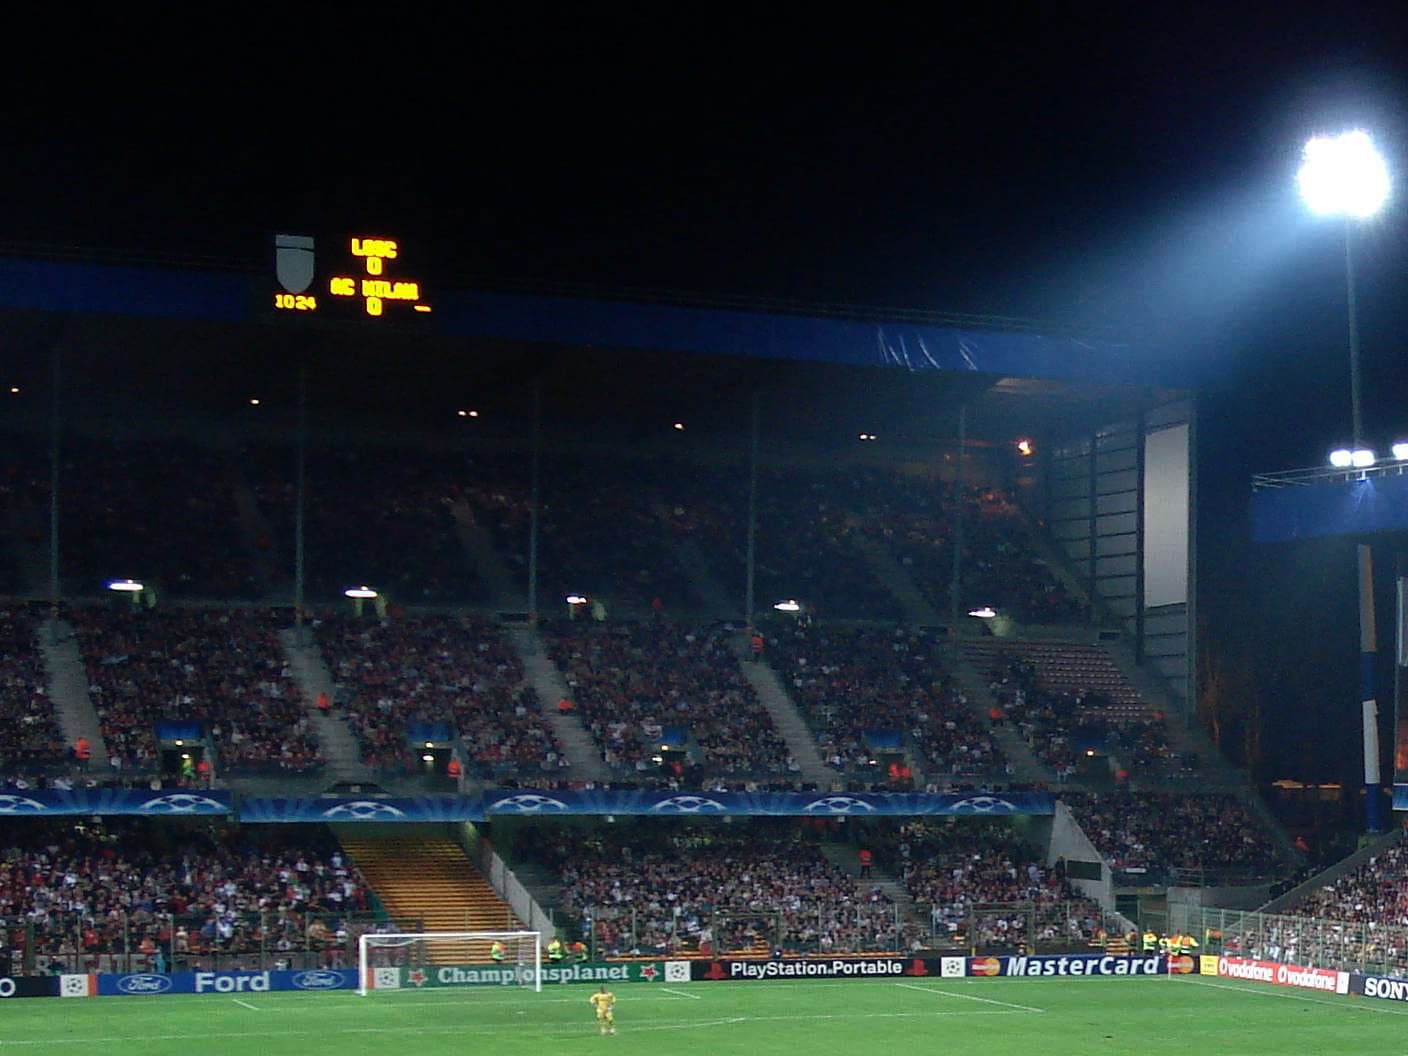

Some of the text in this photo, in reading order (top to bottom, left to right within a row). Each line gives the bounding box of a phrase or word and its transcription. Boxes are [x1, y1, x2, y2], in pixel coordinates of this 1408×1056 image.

[366, 256, 383, 276] 0
[366, 296, 383, 316] 0
[1005, 955, 1160, 977] MasterCard
[1228, 962, 1273, 982] vodafone
[195, 970, 271, 993] Ford
[1287, 969, 1336, 991] vodafone
